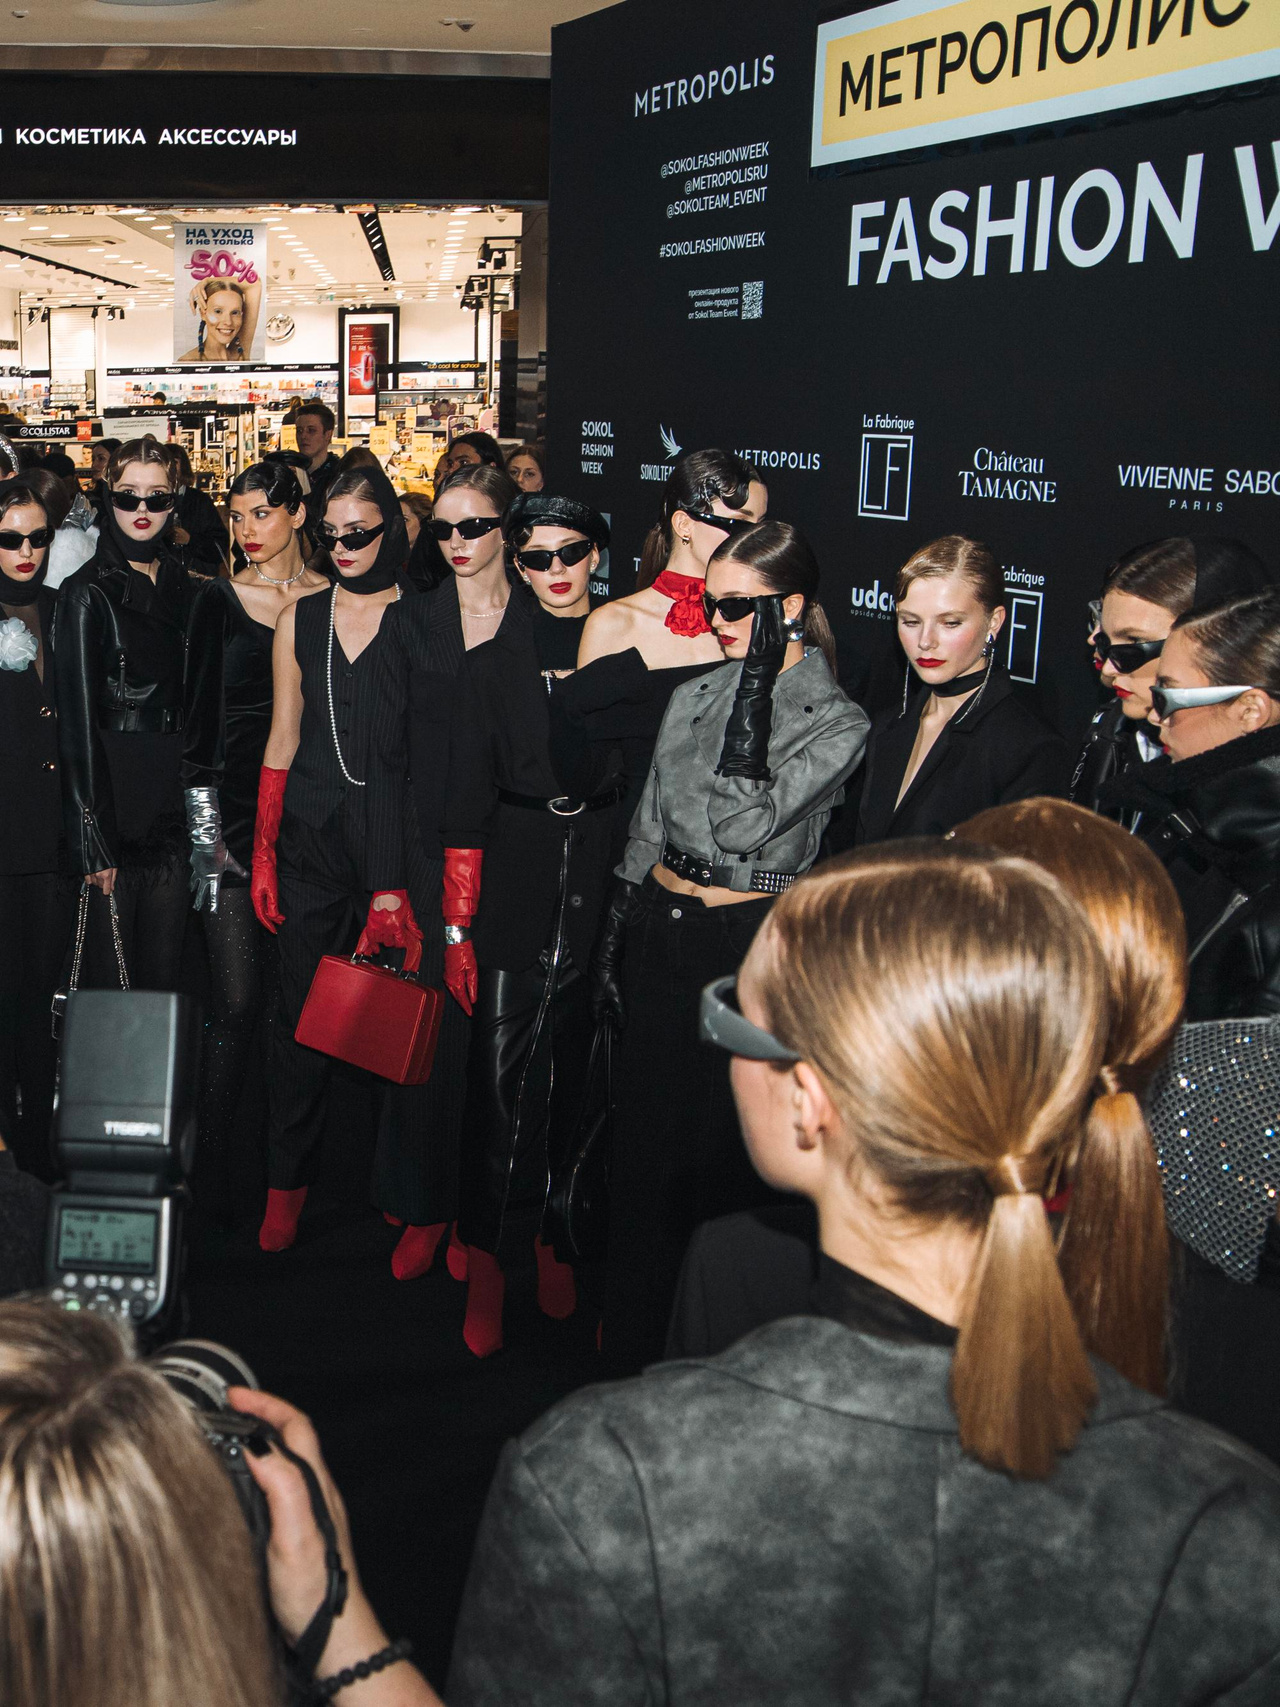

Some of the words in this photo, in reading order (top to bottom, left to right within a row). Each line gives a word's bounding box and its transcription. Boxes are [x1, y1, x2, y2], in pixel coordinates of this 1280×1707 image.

[634, 54, 775, 118] METROPOLIS
[15, 127, 146, 146] КОСМЕТИКА
[158, 128, 298, 147] АКСЕССУАРЫ
[660, 141, 770, 179] @SOKOLFASHIONWEEK
[684, 163, 769, 195] @METROPOLISRU
[666, 186, 768, 219] @SOKOLTEAM_EVENT
[848, 153, 1204, 286] FASHION
[186, 228, 207, 238] НА
[211, 228, 254, 239] УХОД
[659, 231, 766, 258] #SOKOLFASHIONWEEK
[694, 309, 709, 319] Sokol
[709, 309, 723, 318] Team
[723, 308, 738, 317] Event
[28, 427, 71, 436] COLLISTAR
[581, 421, 614, 438] SOKOL
[863, 414, 874, 428] La
[875, 415, 915, 433] Fabrique
[581, 443, 614, 458] FASHION
[973, 447, 1044, 474] Château
[581, 461, 604, 475] WEEK
[1118, 464, 1214, 492] VIVIENNE
[958, 471, 1057, 503] TAMAGNE
[1169, 499, 1224, 512] PARIS
[1002, 565, 1045, 588] abrique
